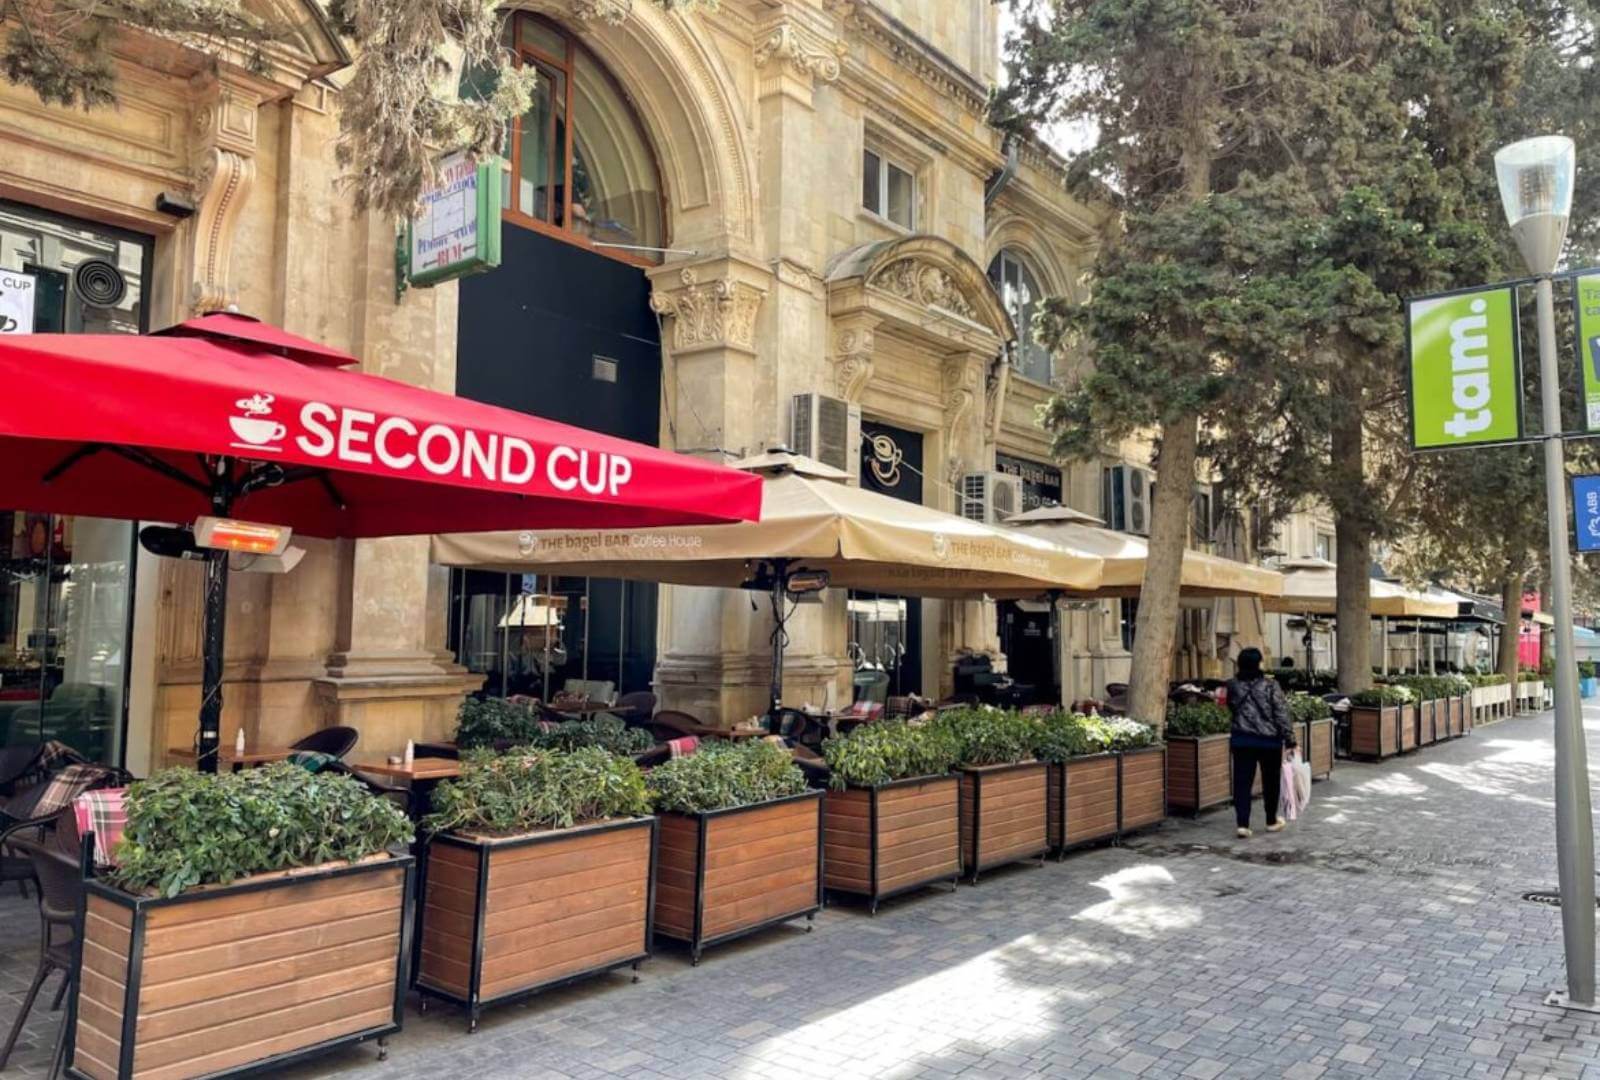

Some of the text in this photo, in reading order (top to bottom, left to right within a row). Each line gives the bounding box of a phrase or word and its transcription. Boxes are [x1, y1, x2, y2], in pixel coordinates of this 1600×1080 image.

[3, 277, 31, 290] CUP
[1444, 298, 1492, 438] tam.
[296, 401, 633, 496] SECOND CUP
[1587, 492, 1598, 515] ABB
[541, 532, 702, 552] THE bagel BAR Coffee House
